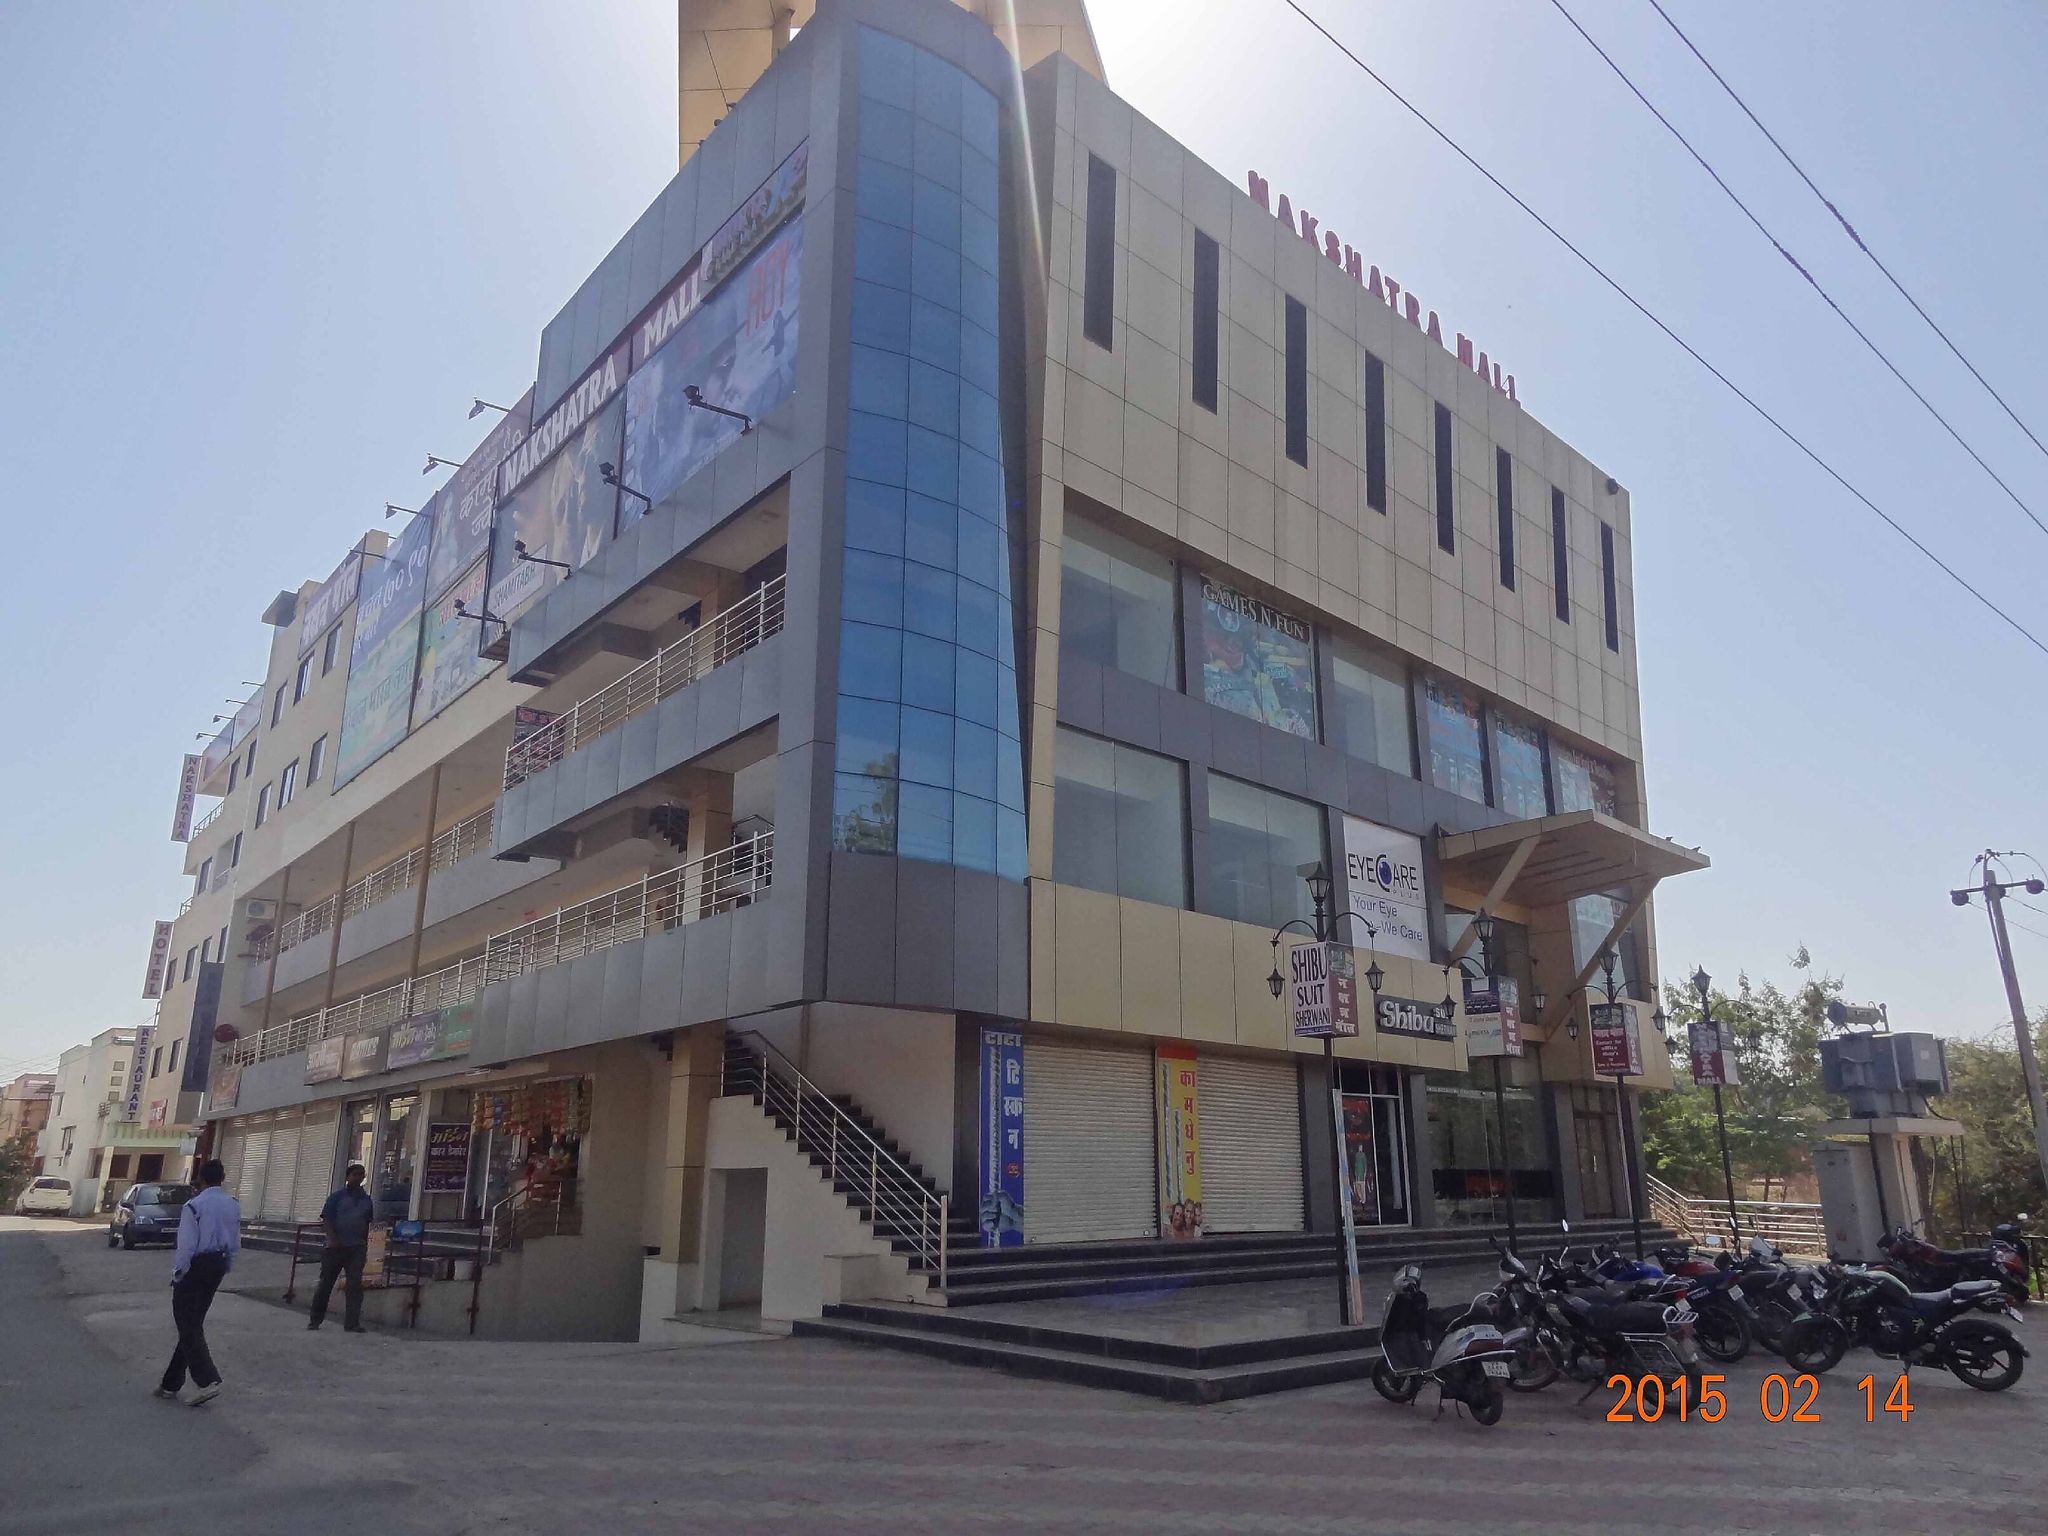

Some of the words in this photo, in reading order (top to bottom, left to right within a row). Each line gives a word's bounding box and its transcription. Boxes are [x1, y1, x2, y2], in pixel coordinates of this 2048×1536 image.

[1248, 169, 1444, 347] NAKSHATRA
[503, 354, 618, 496] NAKSHATRA
[643, 269, 702, 359] MALL
[1203, 584, 1257, 622] GAMES
[1275, 615, 1304, 640] FUN
[177, 756, 199, 840] NAKSHATRA
[1353, 895, 1377, 911] Your
[1380, 901, 1398, 918] Eye
[1400, 925, 1423, 941] Care
[148, 924, 170, 996] HOTEL
[1291, 946, 1328, 984] SHIBU
[1297, 983, 1325, 1007] SUIT
[1295, 1007, 1331, 1028] SHERWANI
[1379, 1000, 1434, 1034] Shibu
[985, 1031, 1022, 1047] टाटा
[126, 1027, 151, 1121] RESTAURANT
